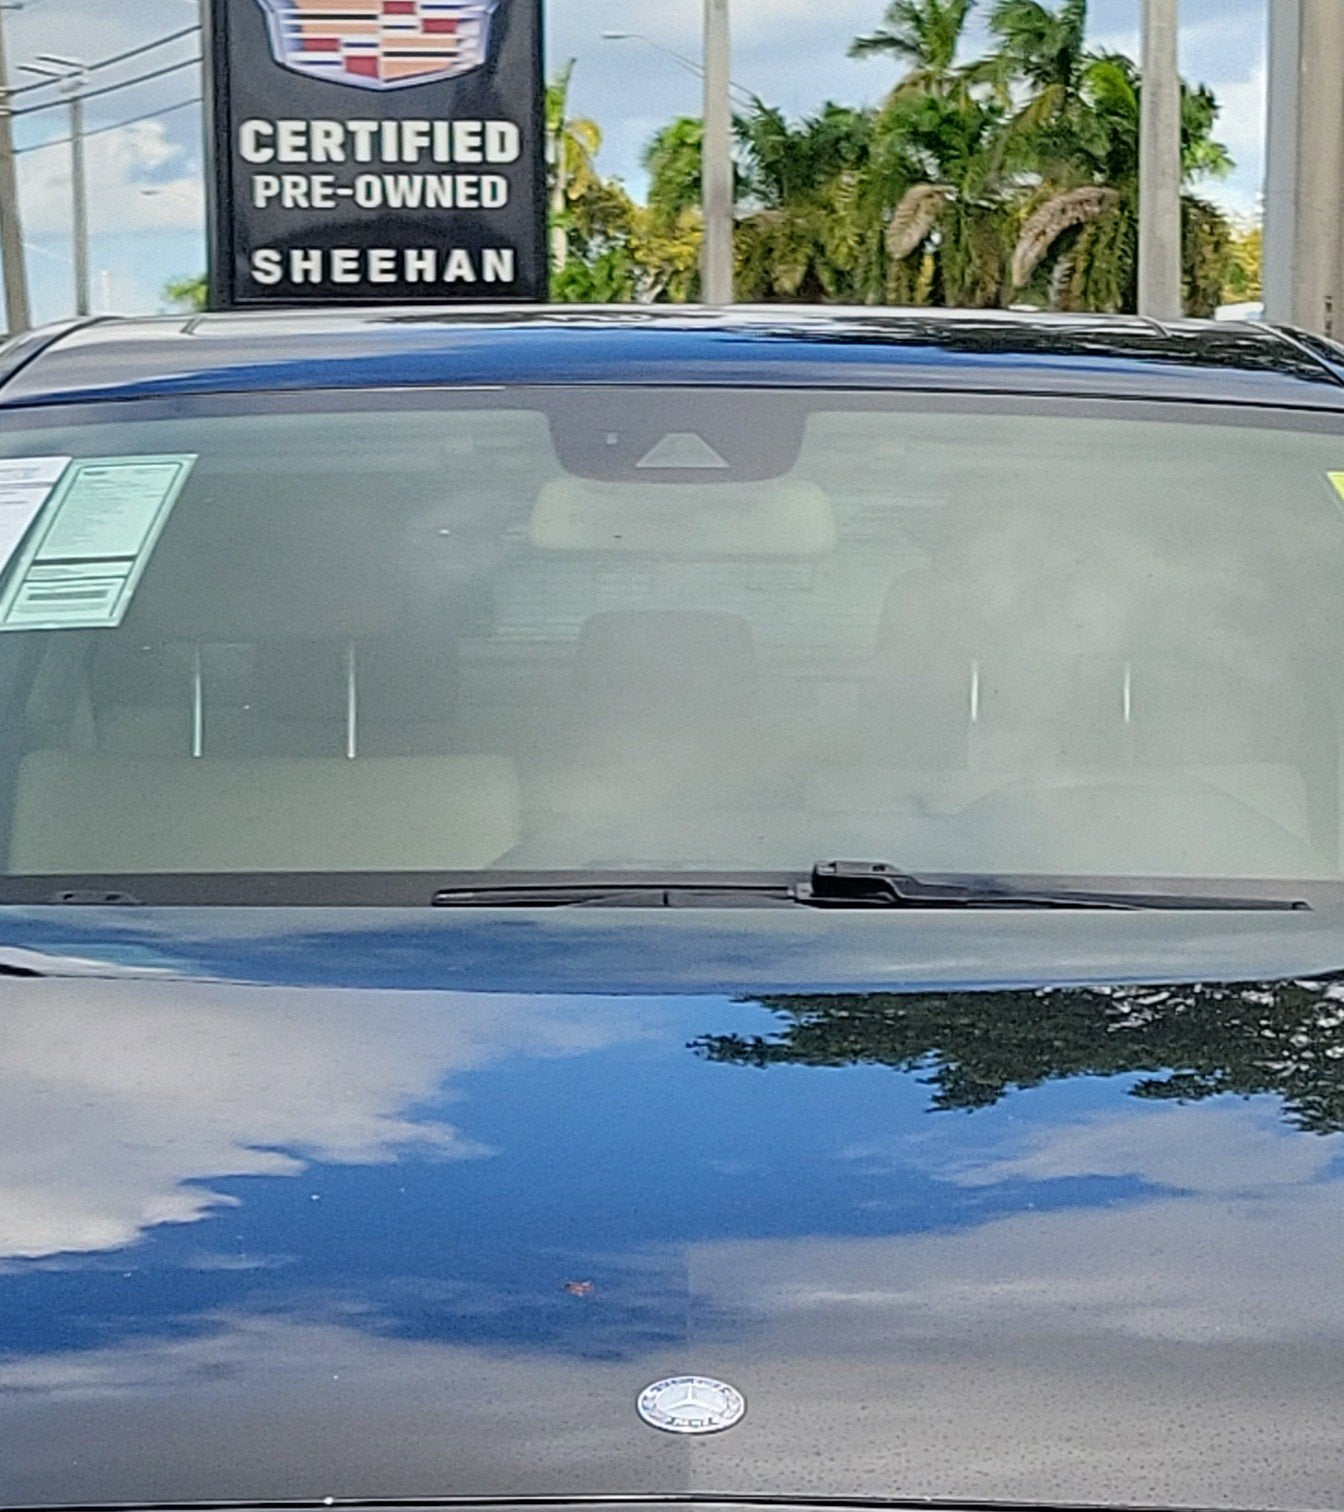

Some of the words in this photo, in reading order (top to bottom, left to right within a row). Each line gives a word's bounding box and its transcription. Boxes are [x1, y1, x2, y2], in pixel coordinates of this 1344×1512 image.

[239, 119, 520, 163] CERTIFIED
[252, 174, 508, 209] PRE-OWNED
[251, 248, 516, 284] SHEEHAN
